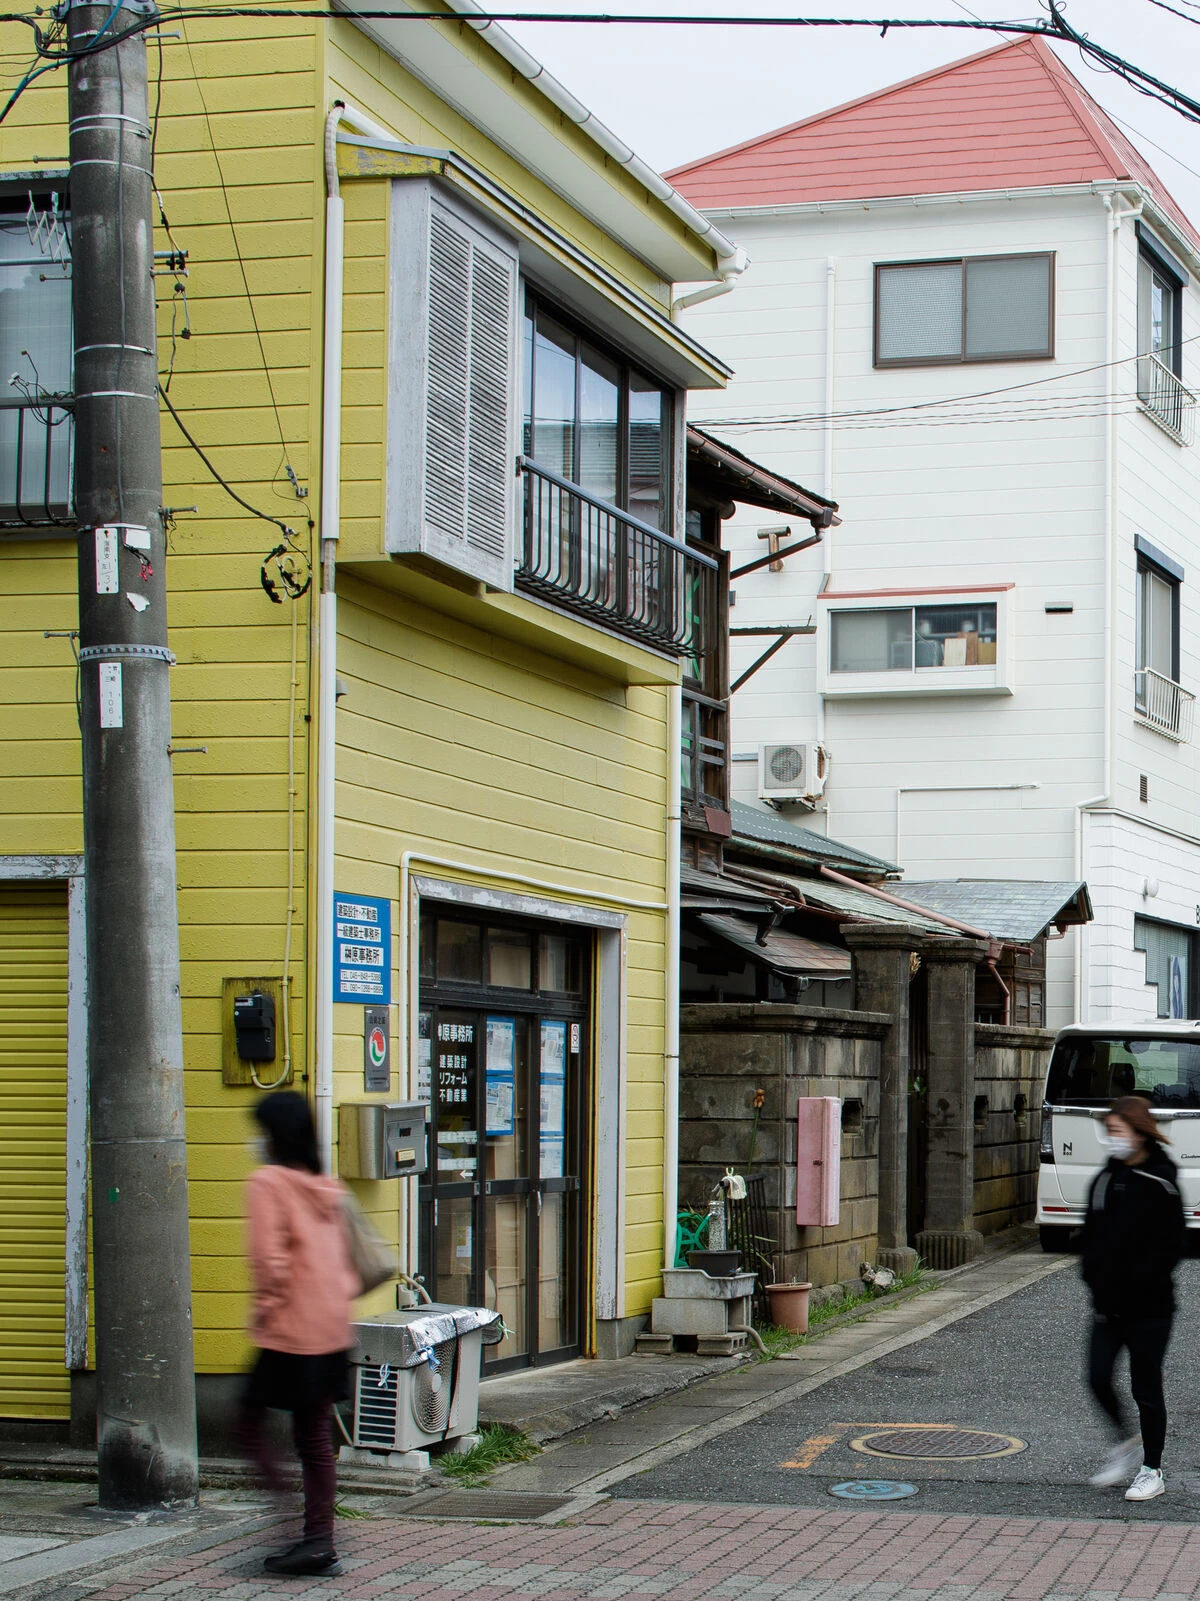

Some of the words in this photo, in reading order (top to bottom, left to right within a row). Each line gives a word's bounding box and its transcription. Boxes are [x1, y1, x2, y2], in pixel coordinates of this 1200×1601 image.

[440, 1055, 467, 1069] 建築設計
[440, 1072, 467, 1085] リフォーム
[440, 1088, 467, 1102] 不動産業
[1063, 1142, 1073, 1151] N
